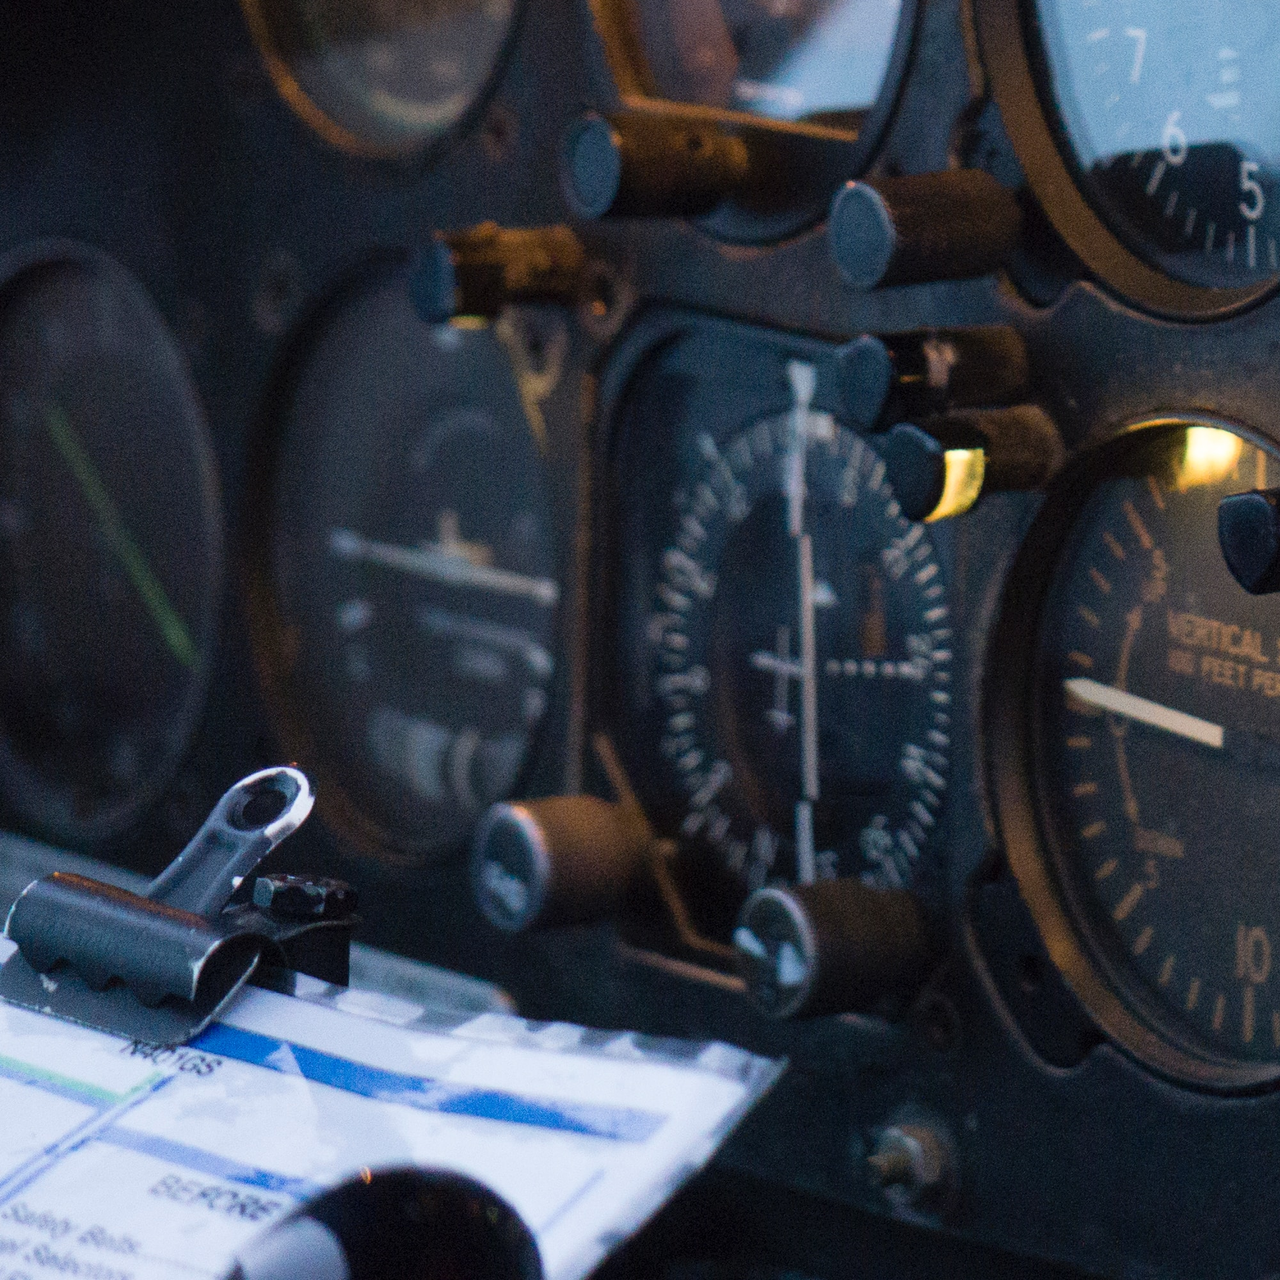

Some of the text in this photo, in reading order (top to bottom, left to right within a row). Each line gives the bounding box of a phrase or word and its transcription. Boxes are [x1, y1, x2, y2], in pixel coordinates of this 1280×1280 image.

[1125, 27, 1148, 84] 7
[1162, 111, 1187, 167] 6
[1239, 161, 1264, 220] 5
[1167, 605, 1269, 663] VERTICAL
[1234, 924, 1272, 983] 10
